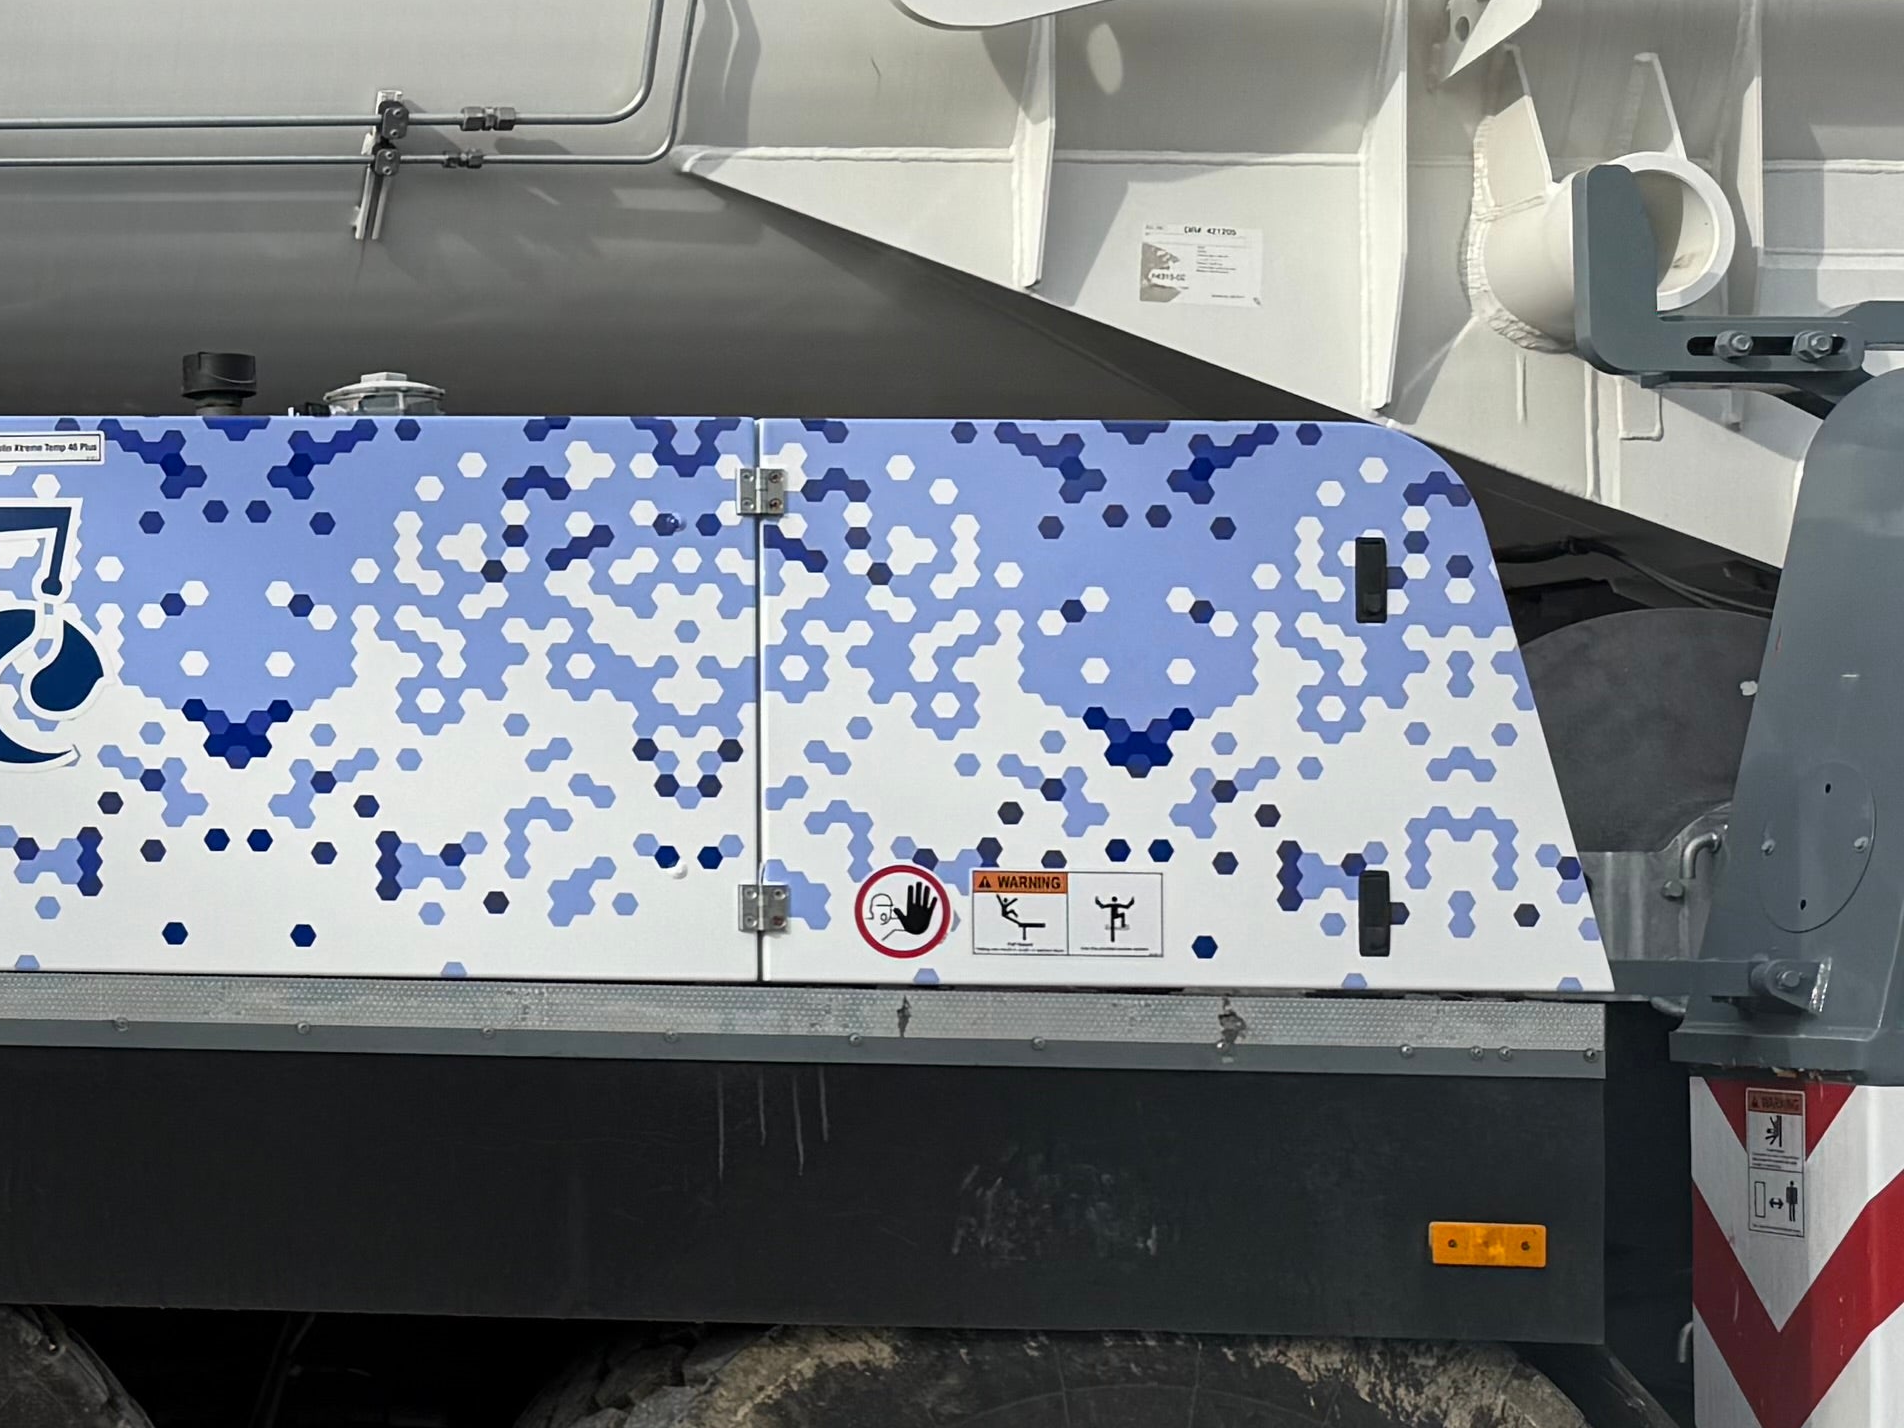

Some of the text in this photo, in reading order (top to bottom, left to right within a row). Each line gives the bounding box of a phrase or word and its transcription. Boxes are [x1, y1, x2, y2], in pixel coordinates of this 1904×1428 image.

[45, 443, 66, 453] Temp
[80, 442, 97, 451] Plus
[997, 875, 1061, 890] WARNING
